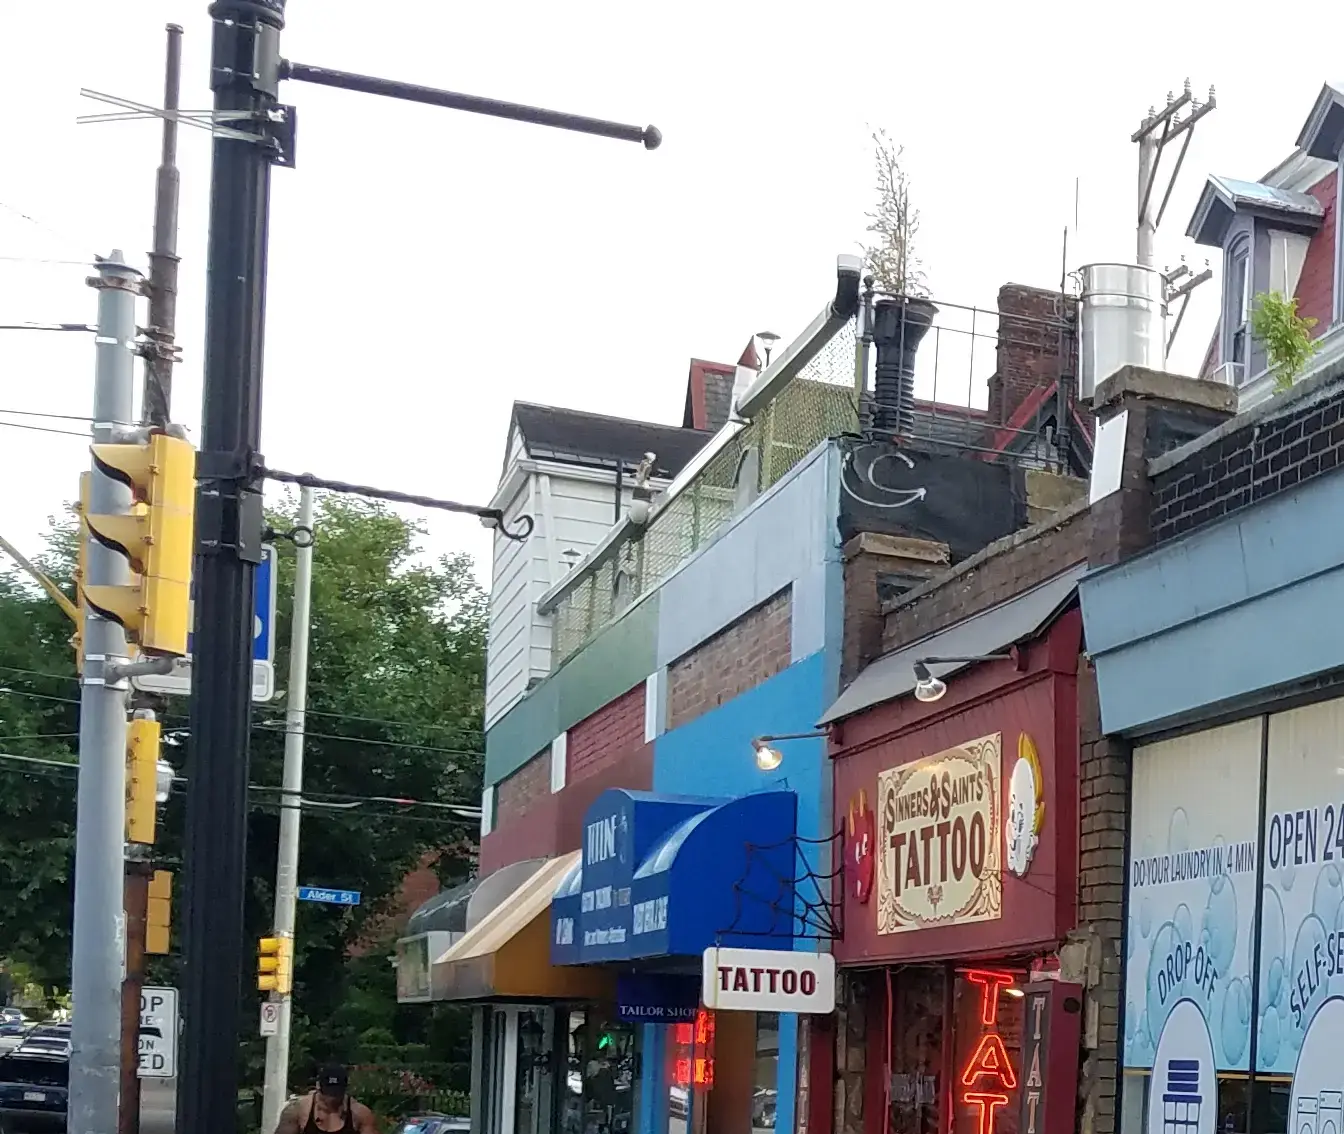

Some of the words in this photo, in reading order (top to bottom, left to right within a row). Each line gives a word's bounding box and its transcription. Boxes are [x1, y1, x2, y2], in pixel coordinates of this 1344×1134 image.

[886, 787, 928, 833] SINNERS
[941, 770, 983, 819] SAINTS
[890, 811, 985, 898] TATTOO
[1171, 848, 1210, 881] LAUNDRY
[1235, 842, 1256, 872] MIN
[1269, 811, 1318, 870] OPEN
[308, 890, 336, 901] Alder
[718, 966, 816, 996] TATTOO
[1157, 941, 1191, 1005] DROP
[1194, 946, 1218, 1000] OFF
[620, 1005, 664, 1017] TAILOR
